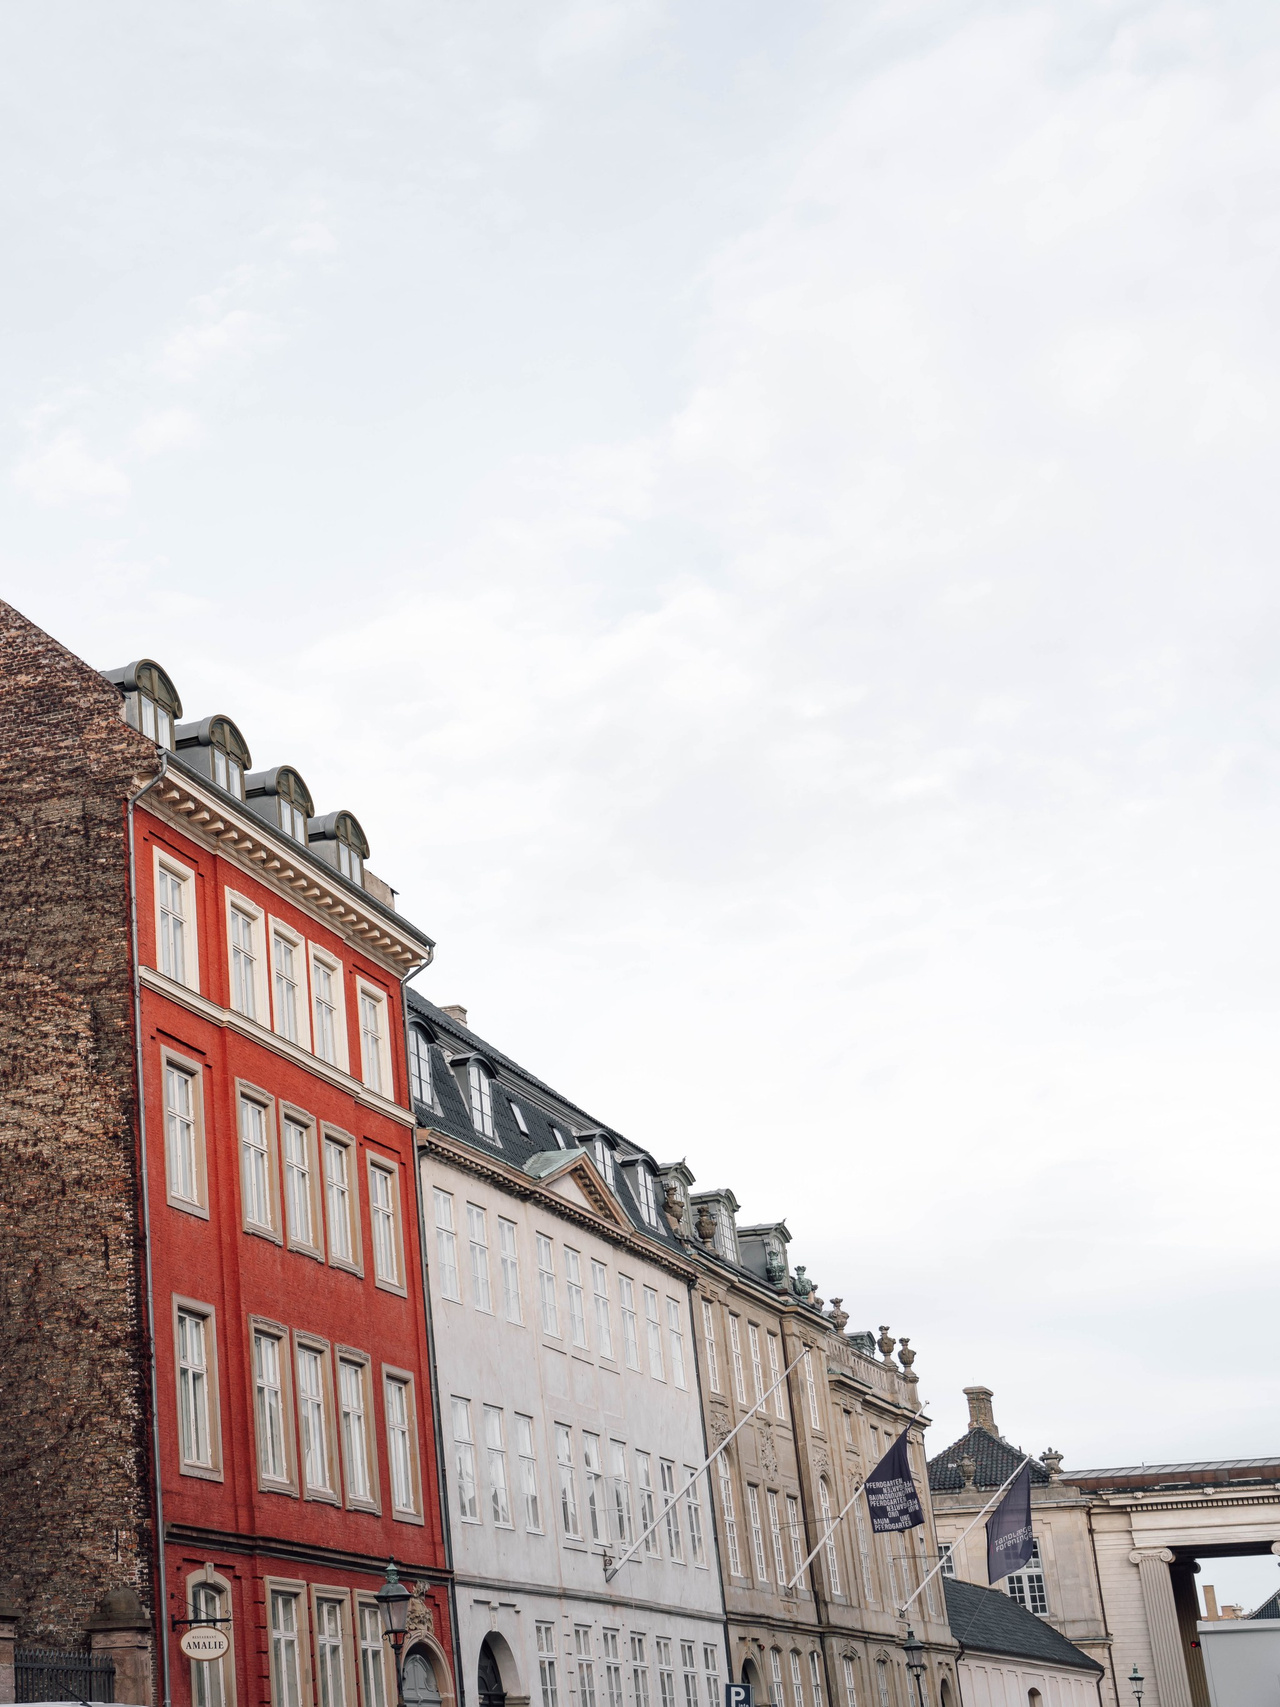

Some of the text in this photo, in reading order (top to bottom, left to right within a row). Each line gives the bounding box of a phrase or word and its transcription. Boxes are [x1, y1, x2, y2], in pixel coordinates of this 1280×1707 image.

[866, 1478, 902, 1489] PFERDGARTEN
[870, 1496, 907, 1507] PFERDGARTEN
[874, 1521, 912, 1531] PFERDGARTEN
[186, 1641, 224, 1650] AMALIE
[731, 1687, 745, 1707] P
